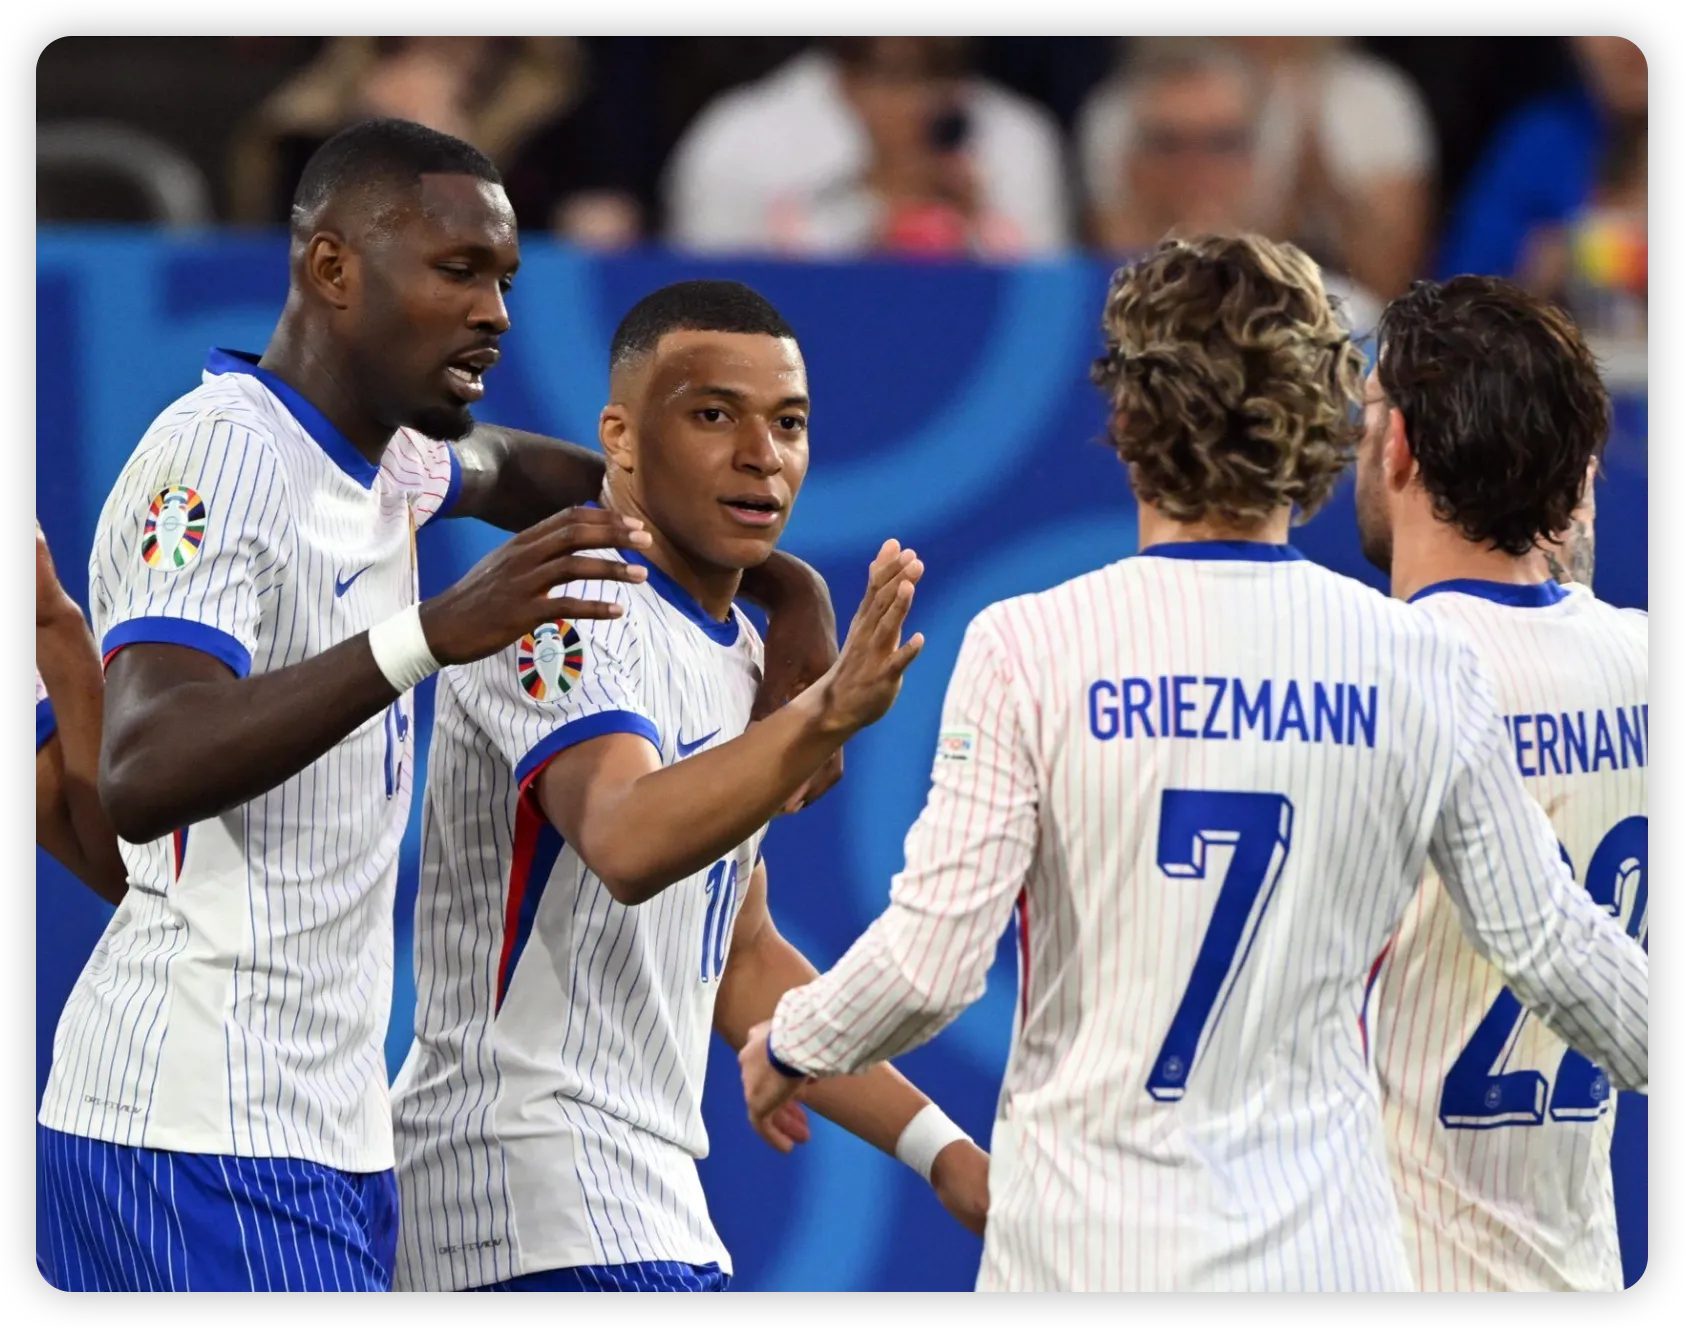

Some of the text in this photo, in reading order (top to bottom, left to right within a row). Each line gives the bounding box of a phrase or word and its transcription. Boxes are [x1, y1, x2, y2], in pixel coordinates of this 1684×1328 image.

[1088, 675, 1378, 748] GRIEZMANN
[1504, 704, 1648, 776] ERNAN
[701, 859, 738, 983] 10
[1145, 788, 1294, 1102] 7
